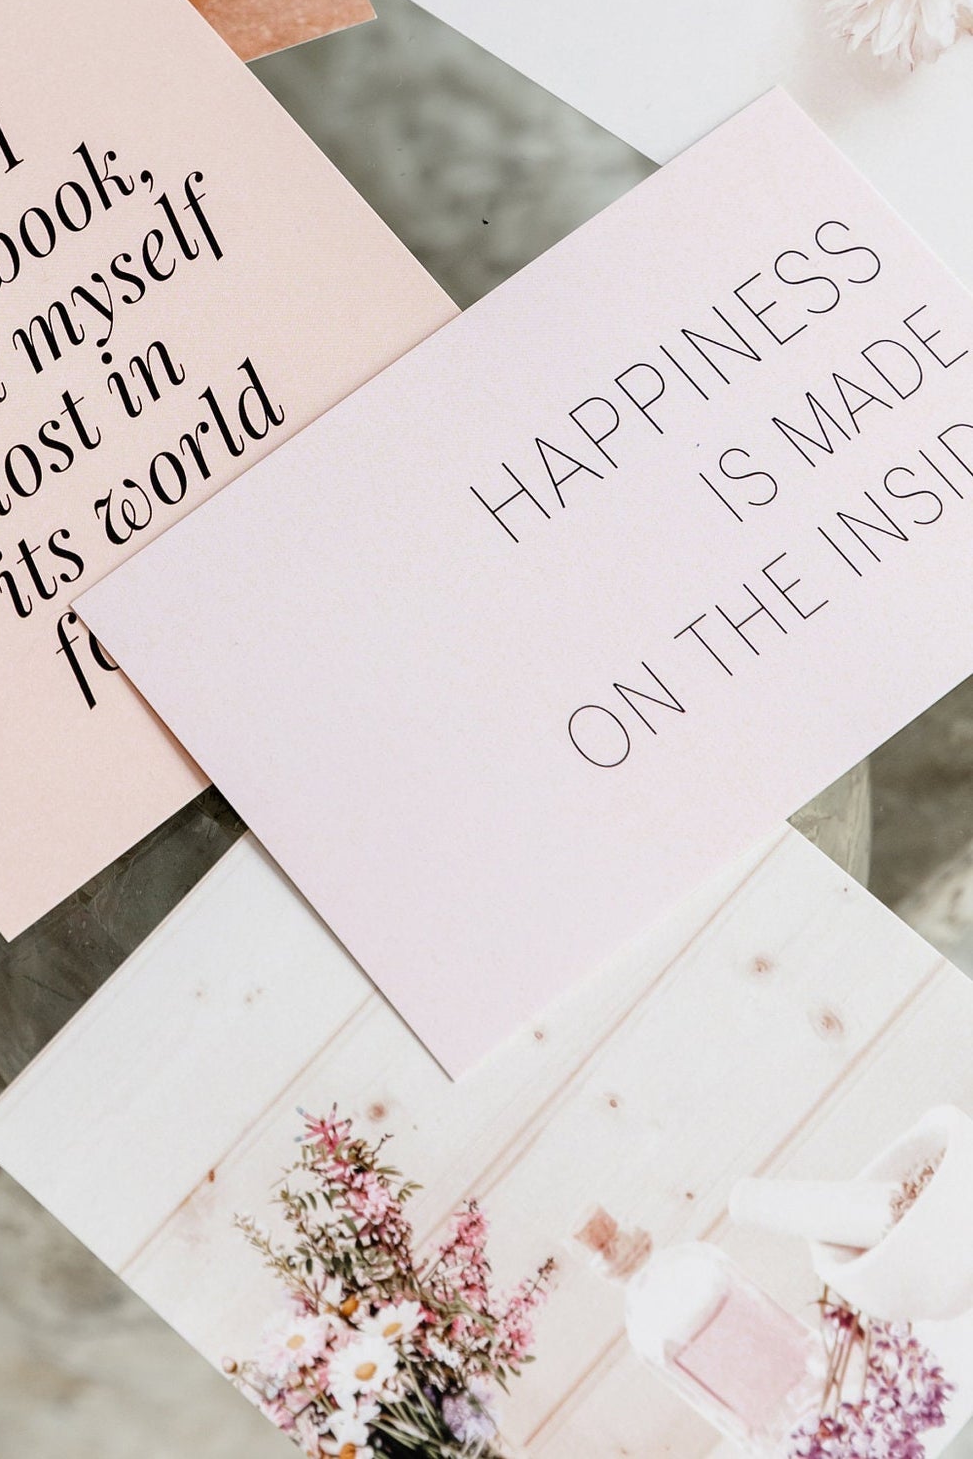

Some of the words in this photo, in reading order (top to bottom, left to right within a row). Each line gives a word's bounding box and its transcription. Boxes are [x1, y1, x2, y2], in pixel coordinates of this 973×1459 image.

[12, 170, 224, 375] myself
[94, 357, 285, 546] world
[101, 350, 186, 418] in
[469, 221, 881, 543] HAPPINESS
[699, 448, 778, 522] IS
[771, 305, 969, 468] MADE
[568, 661, 686, 768] ON
[674, 552, 829, 676] THE
